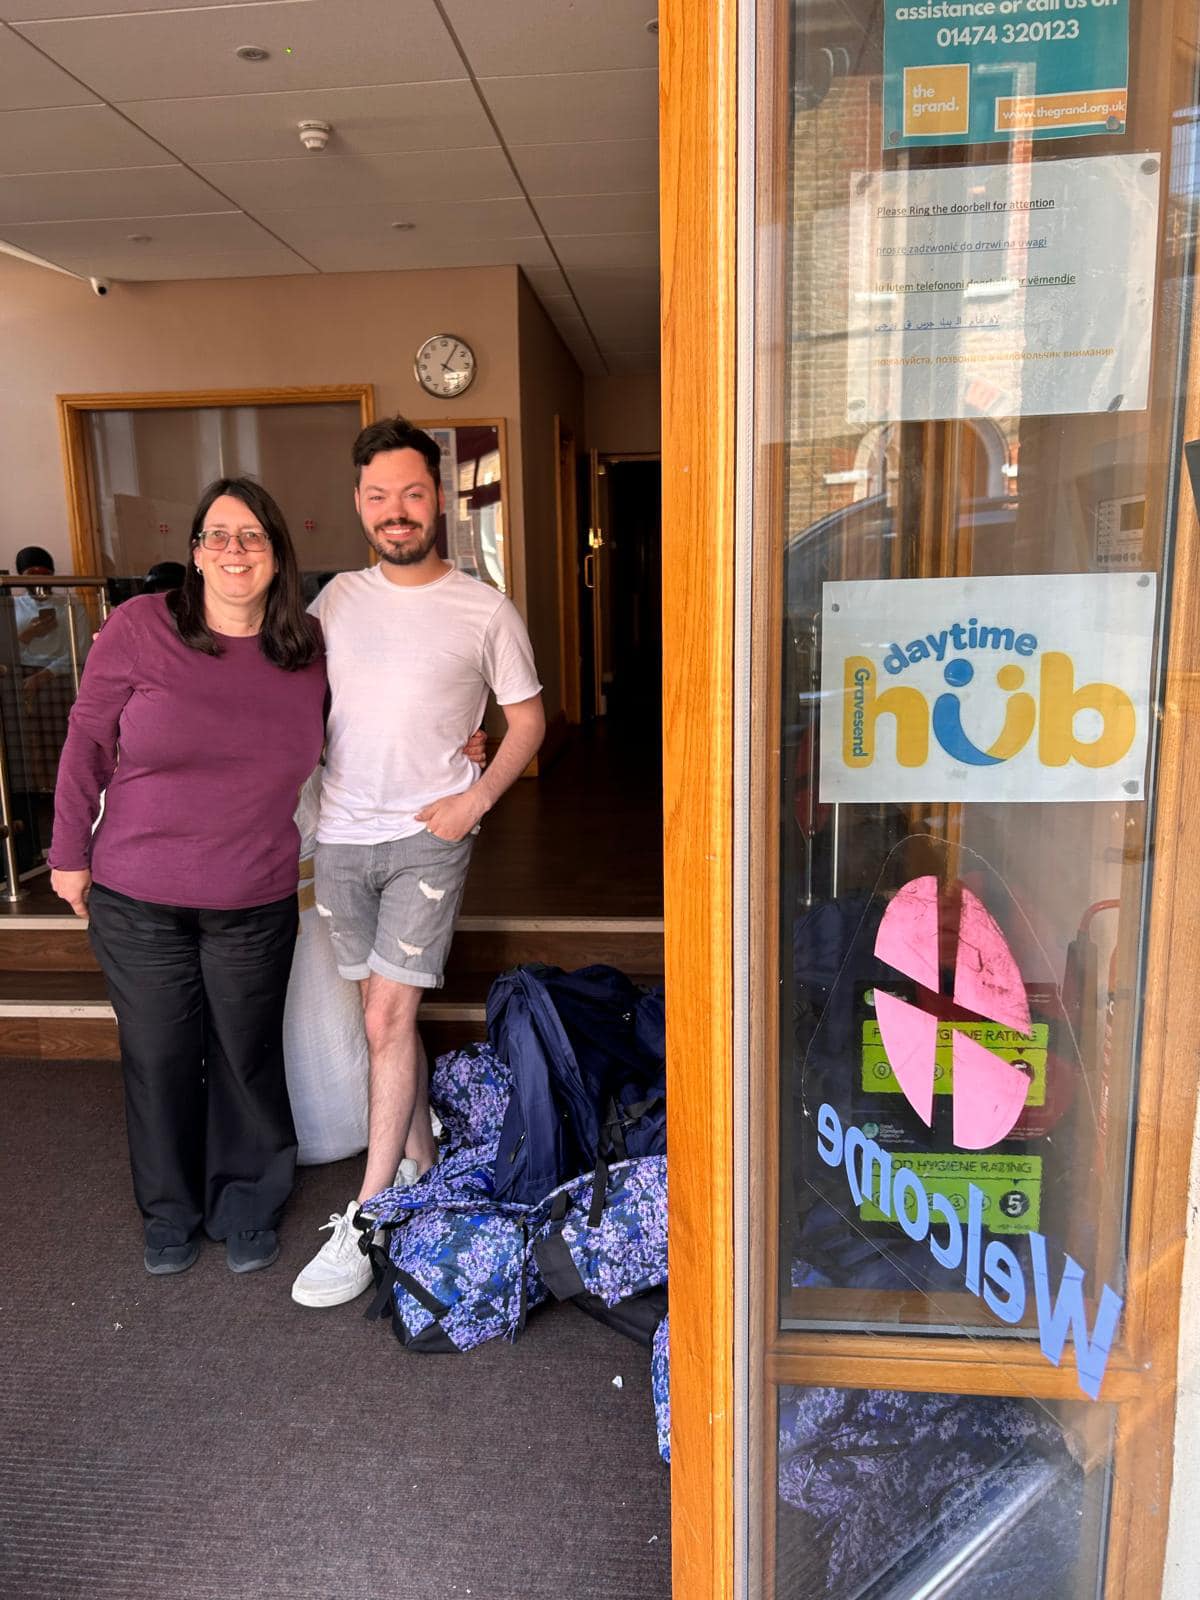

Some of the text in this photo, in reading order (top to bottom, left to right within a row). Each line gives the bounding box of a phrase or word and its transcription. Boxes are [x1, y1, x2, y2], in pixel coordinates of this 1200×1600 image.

[895, 0, 995, 20] assistance
[999, 0, 1021, 14] or
[1026, 0, 1060, 12] call
[936, 19, 1080, 48] 01474 320123
[912, 84, 935, 98] the
[912, 97, 960, 118] grand.
[1002, 102, 1126, 120] www.thegrand.org.uk
[877, 198, 1055, 217] Please Ring the doorbell for attention
[960, 241, 973, 251] do
[975, 239, 1001, 250] drzwi
[1003, 240, 1016, 249] na
[1018, 236, 1048, 249] uwagi
[916, 280, 965, 291] telefononi
[1028, 274, 1076, 286] vëmendje
[883, 618, 1038, 675] daytime
[853, 668, 870, 757] Gravesend
[872, 1158, 1032, 1174] FOD HYGIENE RATING
[1006, 1194, 1023, 1215] 5
